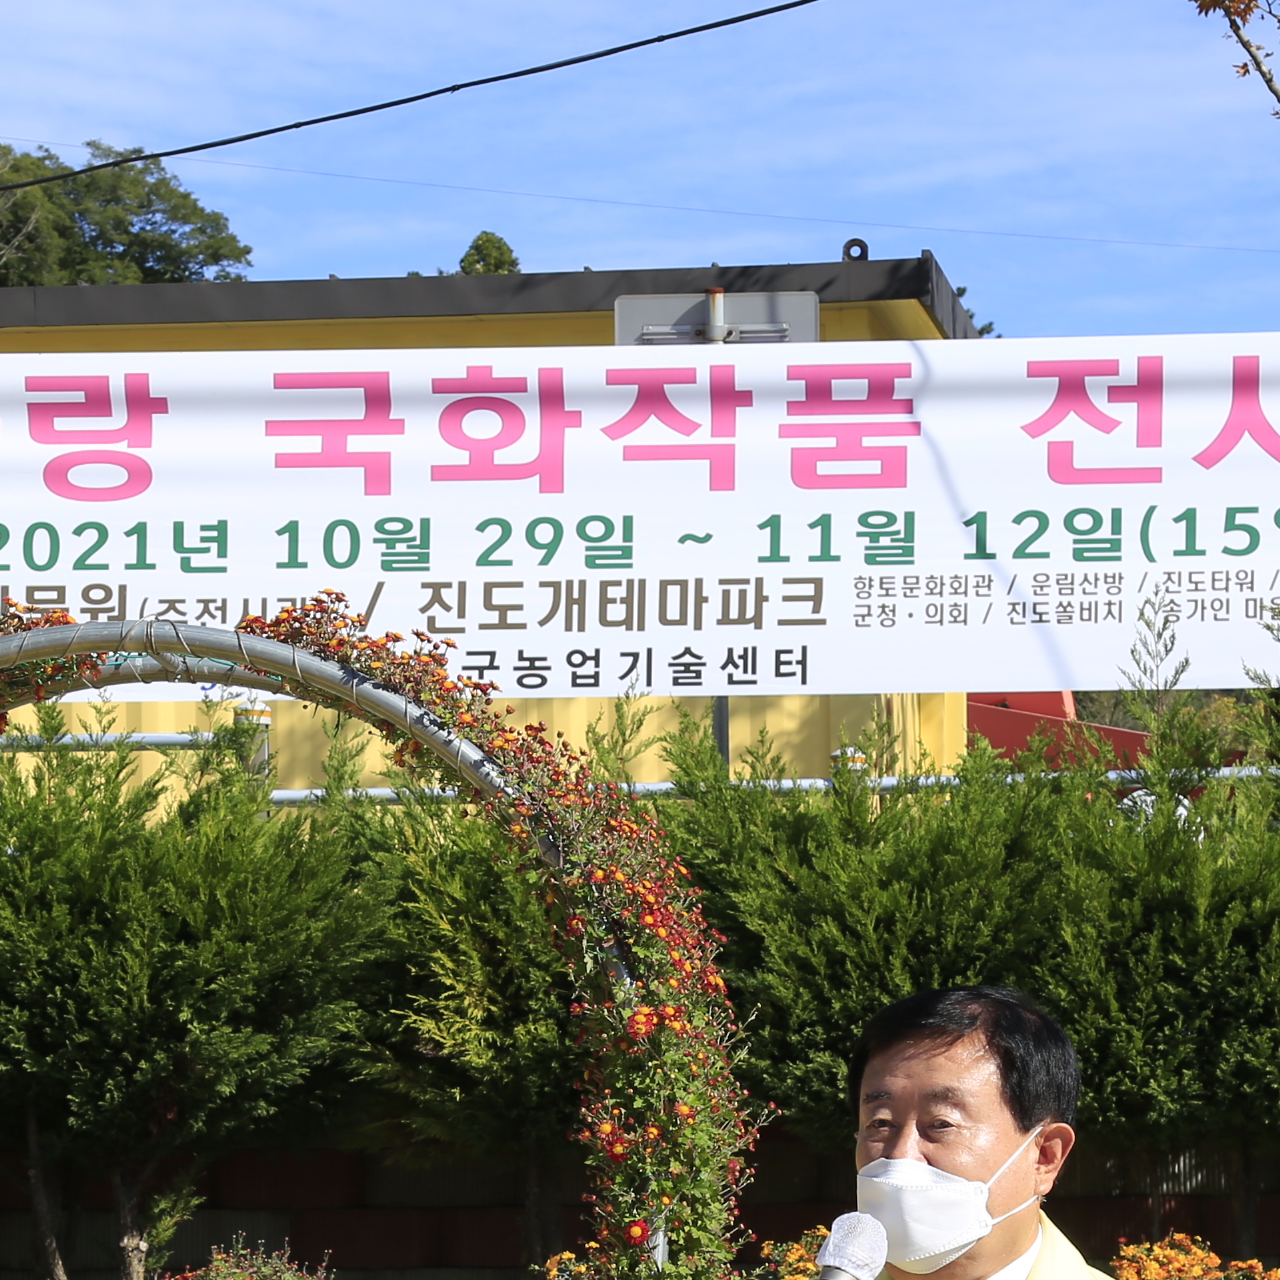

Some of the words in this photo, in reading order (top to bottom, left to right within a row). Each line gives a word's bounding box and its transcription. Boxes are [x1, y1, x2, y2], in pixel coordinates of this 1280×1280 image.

[264, 362, 921, 497] 국화작품
[275, 516, 432, 573] 10월
[475, 514, 634, 570] 29일
[756, 509, 917, 566] 11월
[418, 576, 827, 634] 진도개테마파크
[853, 574, 994, 600] 향토문화회관
[1031, 572, 1125, 597] 운림산방
[1162, 569, 1256, 594] 진도타워
[1007, 600, 1124, 626] 진도쏠비치
[1162, 597, 1231, 623] 송가인
